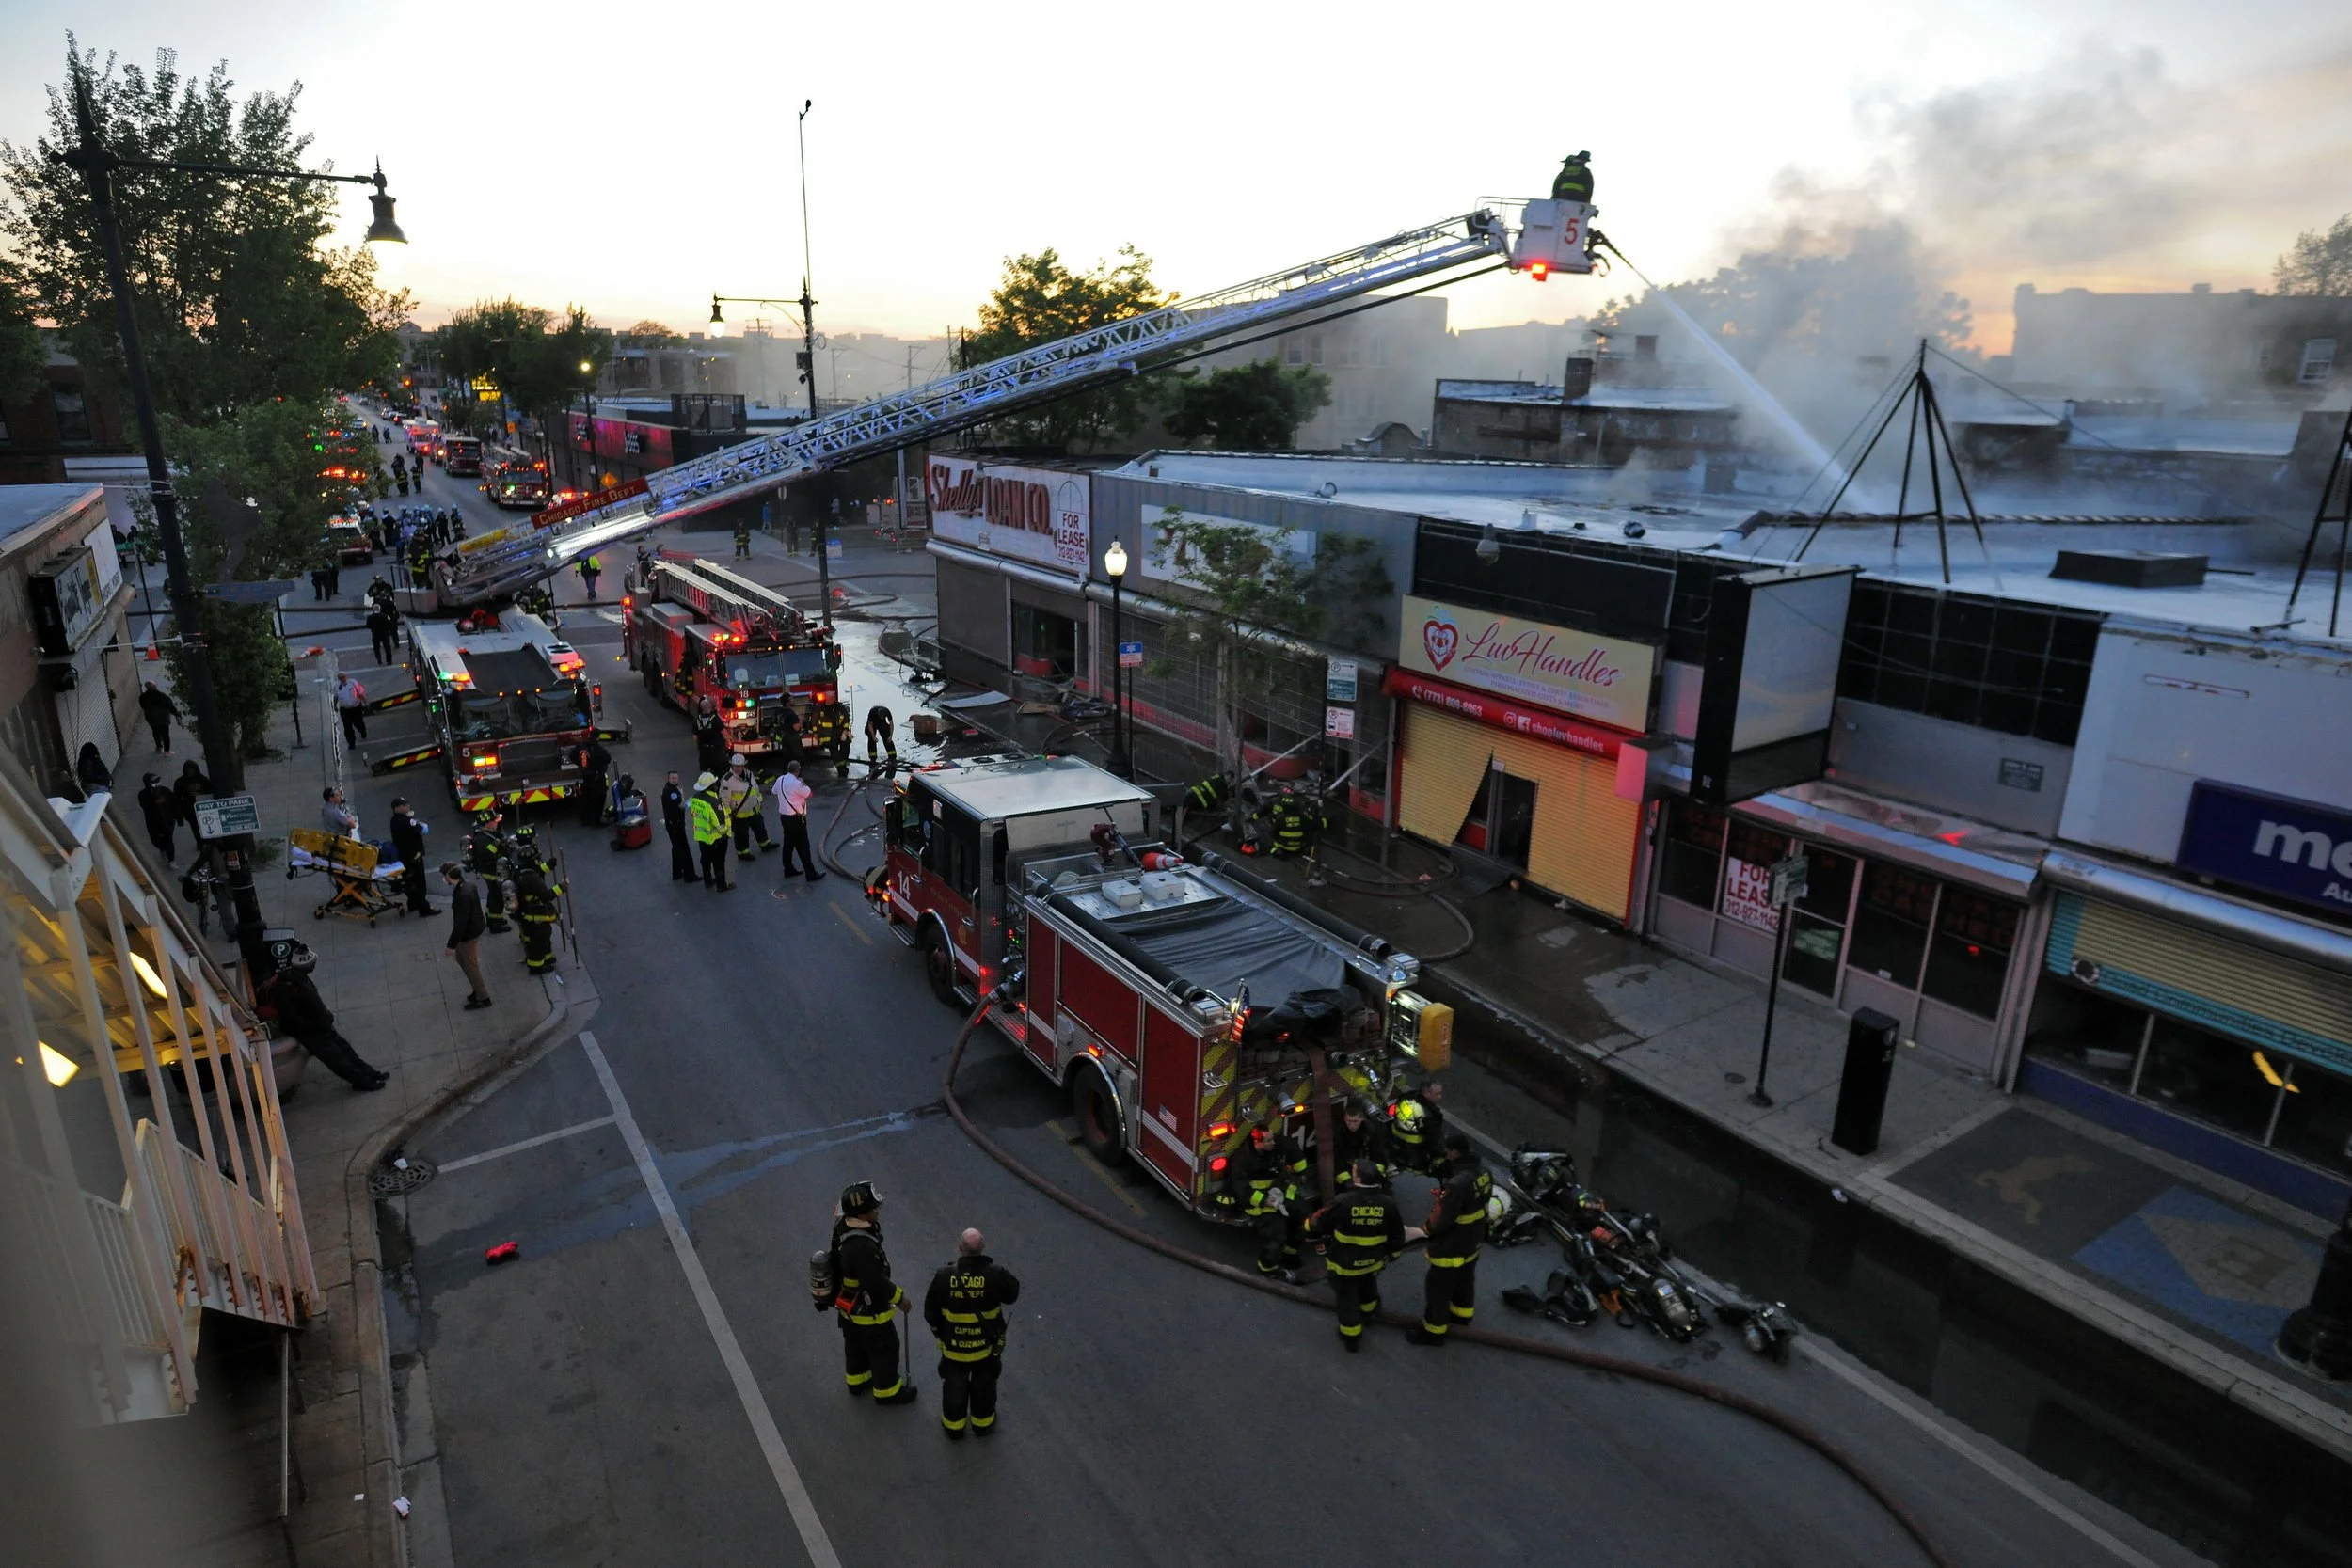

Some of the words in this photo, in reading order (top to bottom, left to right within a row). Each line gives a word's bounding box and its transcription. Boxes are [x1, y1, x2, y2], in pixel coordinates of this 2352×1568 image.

[1565, 217, 1579, 245] 5
[539, 505, 581, 525] CHICAGO
[583, 496, 607, 511] FIRE
[985, 475, 1025, 530] LOAN
[1026, 483, 1053, 535] CO.
[1062, 513, 1079, 529] FOR
[1057, 528, 1085, 548] LEASE
[1462, 622, 1619, 686] LuvHandles
[739, 689, 749, 699] 18
[462, 747, 470, 758] 5
[229, 798, 250, 806] PARK
[897, 870, 912, 901] 14
[1727, 877, 1781, 912] LEAS
[1351, 1206, 1384, 1218] CHICAGO
[950, 1275, 985, 1289] CCAGO
[954, 1326, 982, 1336] CAPTAIN
[958, 1338, 986, 1349] GUZMAN
